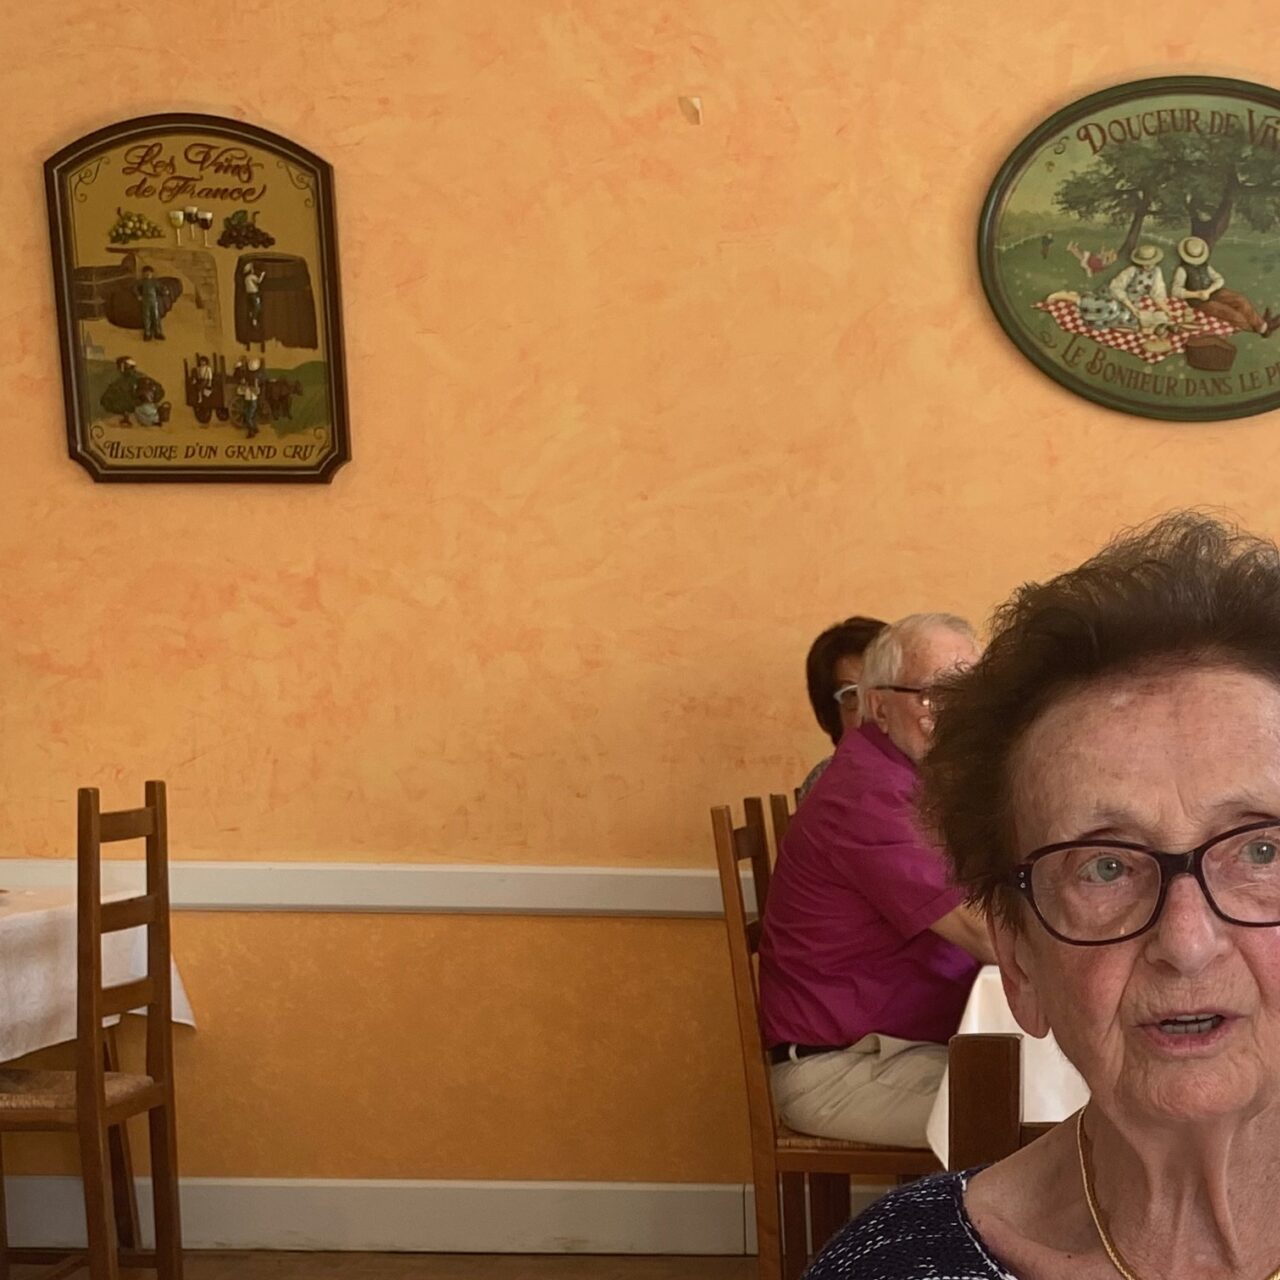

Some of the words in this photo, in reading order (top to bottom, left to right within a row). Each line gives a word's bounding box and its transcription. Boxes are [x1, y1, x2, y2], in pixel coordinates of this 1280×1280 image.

[1076, 108, 1200, 156] DOUCEUR
[1209, 110, 1239, 136] DE
[122, 142, 176, 177] Les
[184, 143, 264, 183] Vins
[125, 177, 156, 198] de
[159, 175, 267, 203] France
[1061, 334, 1082, 366] LE
[1087, 348, 1178, 397] BONHEUR
[1185, 376, 1233, 397] DANS
[1239, 371, 1261, 390] LE
[103, 441, 178, 461] HISTOIRE
[184, 442, 218, 460] D'UN
[225, 444, 277, 461] GRAND
[282, 444, 316, 461] CRU
